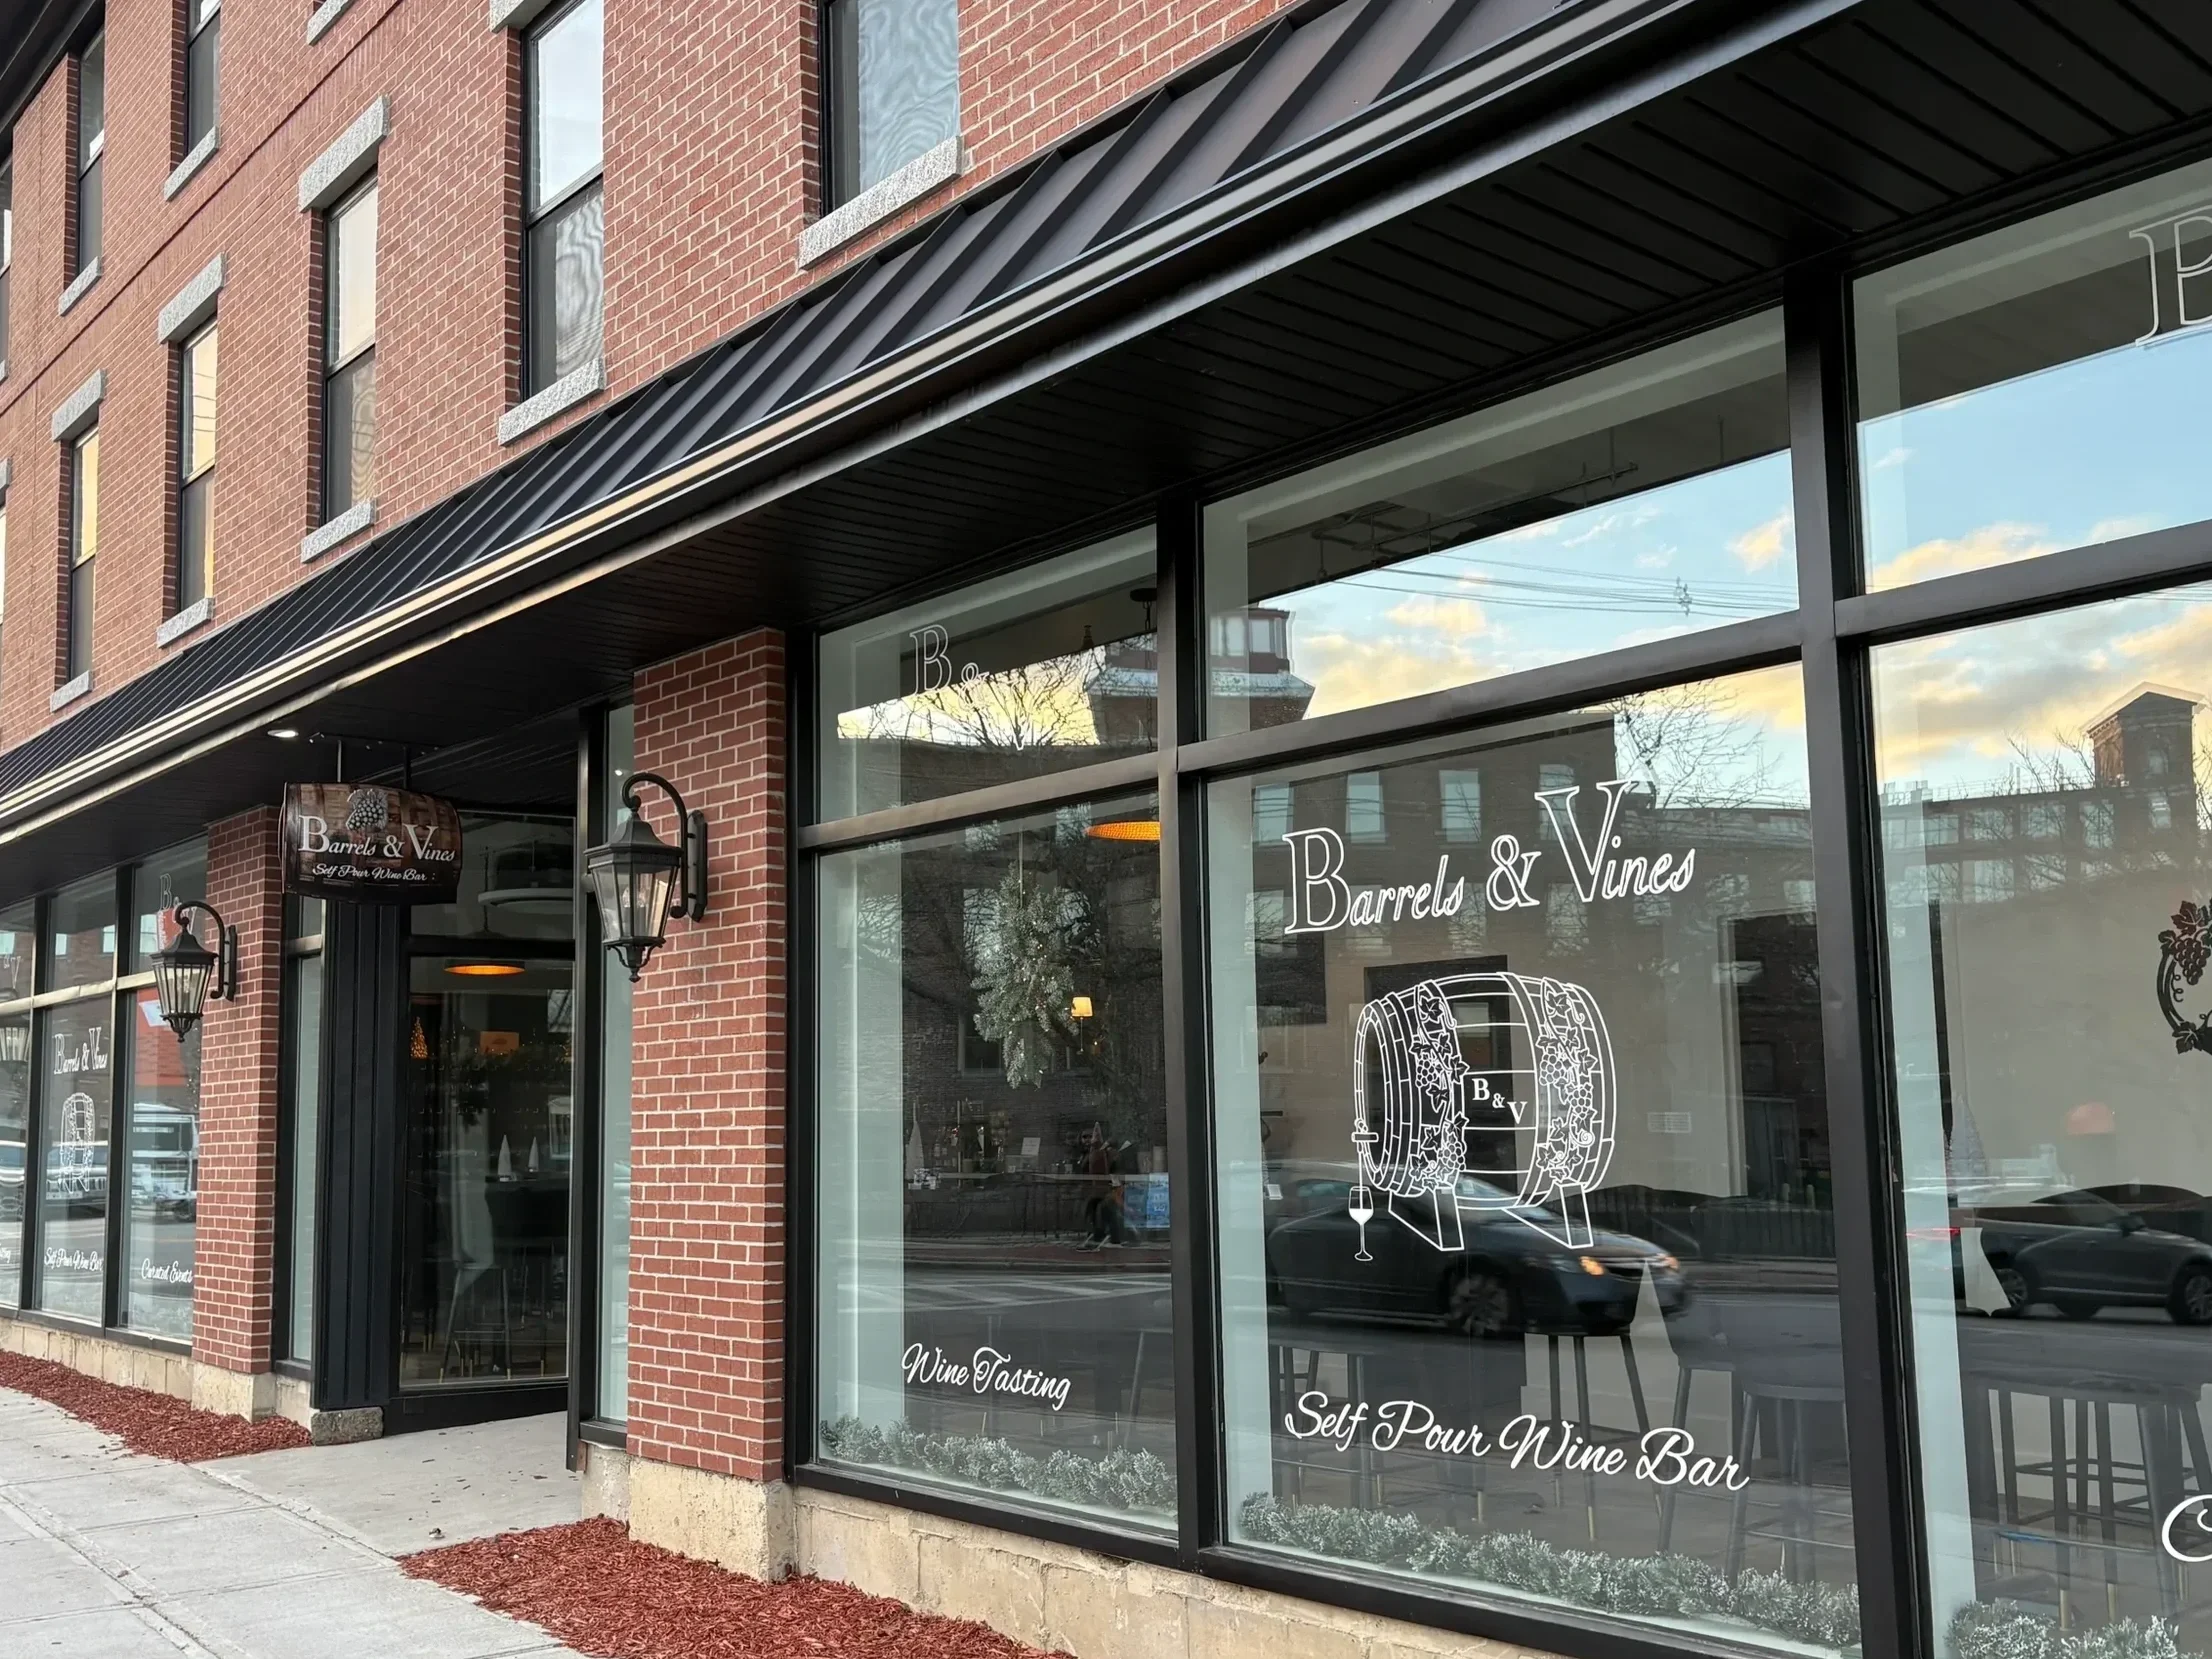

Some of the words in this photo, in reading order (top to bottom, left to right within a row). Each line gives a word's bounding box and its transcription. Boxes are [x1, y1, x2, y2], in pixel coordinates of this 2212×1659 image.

[909, 624, 952, 697] B
[299, 815, 376, 856] Barrels
[383, 835, 405, 859] &
[404, 823, 456, 862] Vines
[312, 863, 339, 878] Self
[337, 864, 371, 878] Pour
[371, 867, 402, 880] Wine
[402, 868, 427, 881] Bar
[1282, 827, 1465, 935] Barrels
[1486, 835, 1541, 911] &
[1534, 780, 1697, 903] Vines
[1472, 1078, 1490, 1100] B
[1492, 1093, 1505, 1108] &
[1507, 1101, 1528, 1124] V
[900, 1342, 970, 1386] Wine
[972, 1346, 1072, 1412] Tasting
[1284, 1390, 1368, 1452] Self
[1371, 1400, 1492, 1458] Pour
[1498, 1414, 1628, 1476] Wine
[1635, 1427, 1750, 1491] Bar
